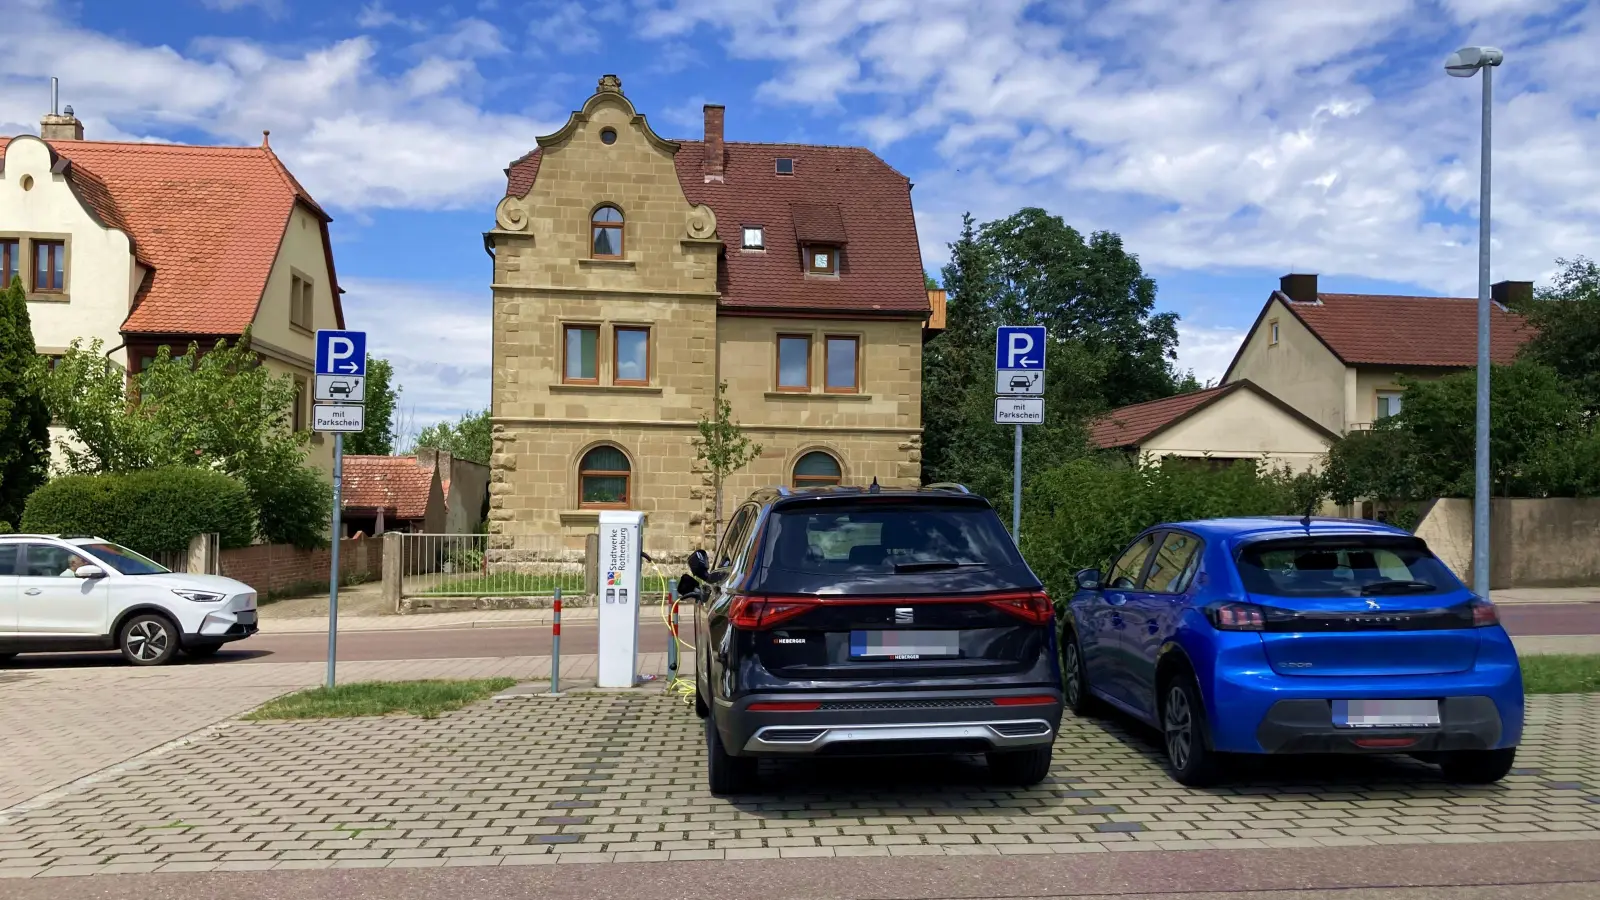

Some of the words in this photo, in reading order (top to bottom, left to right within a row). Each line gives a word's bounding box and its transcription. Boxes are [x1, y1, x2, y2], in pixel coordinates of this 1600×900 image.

[327, 336, 355, 373] P
[1007, 332, 1034, 368] P
[332, 410, 345, 418] mit
[999, 411, 1040, 419] Parkschein
[1013, 403, 1026, 411] mit
[317, 418, 360, 427] Parkschein
[609, 529, 618, 571] Stadtwerke
[618, 527, 628, 571] Rothenburg
